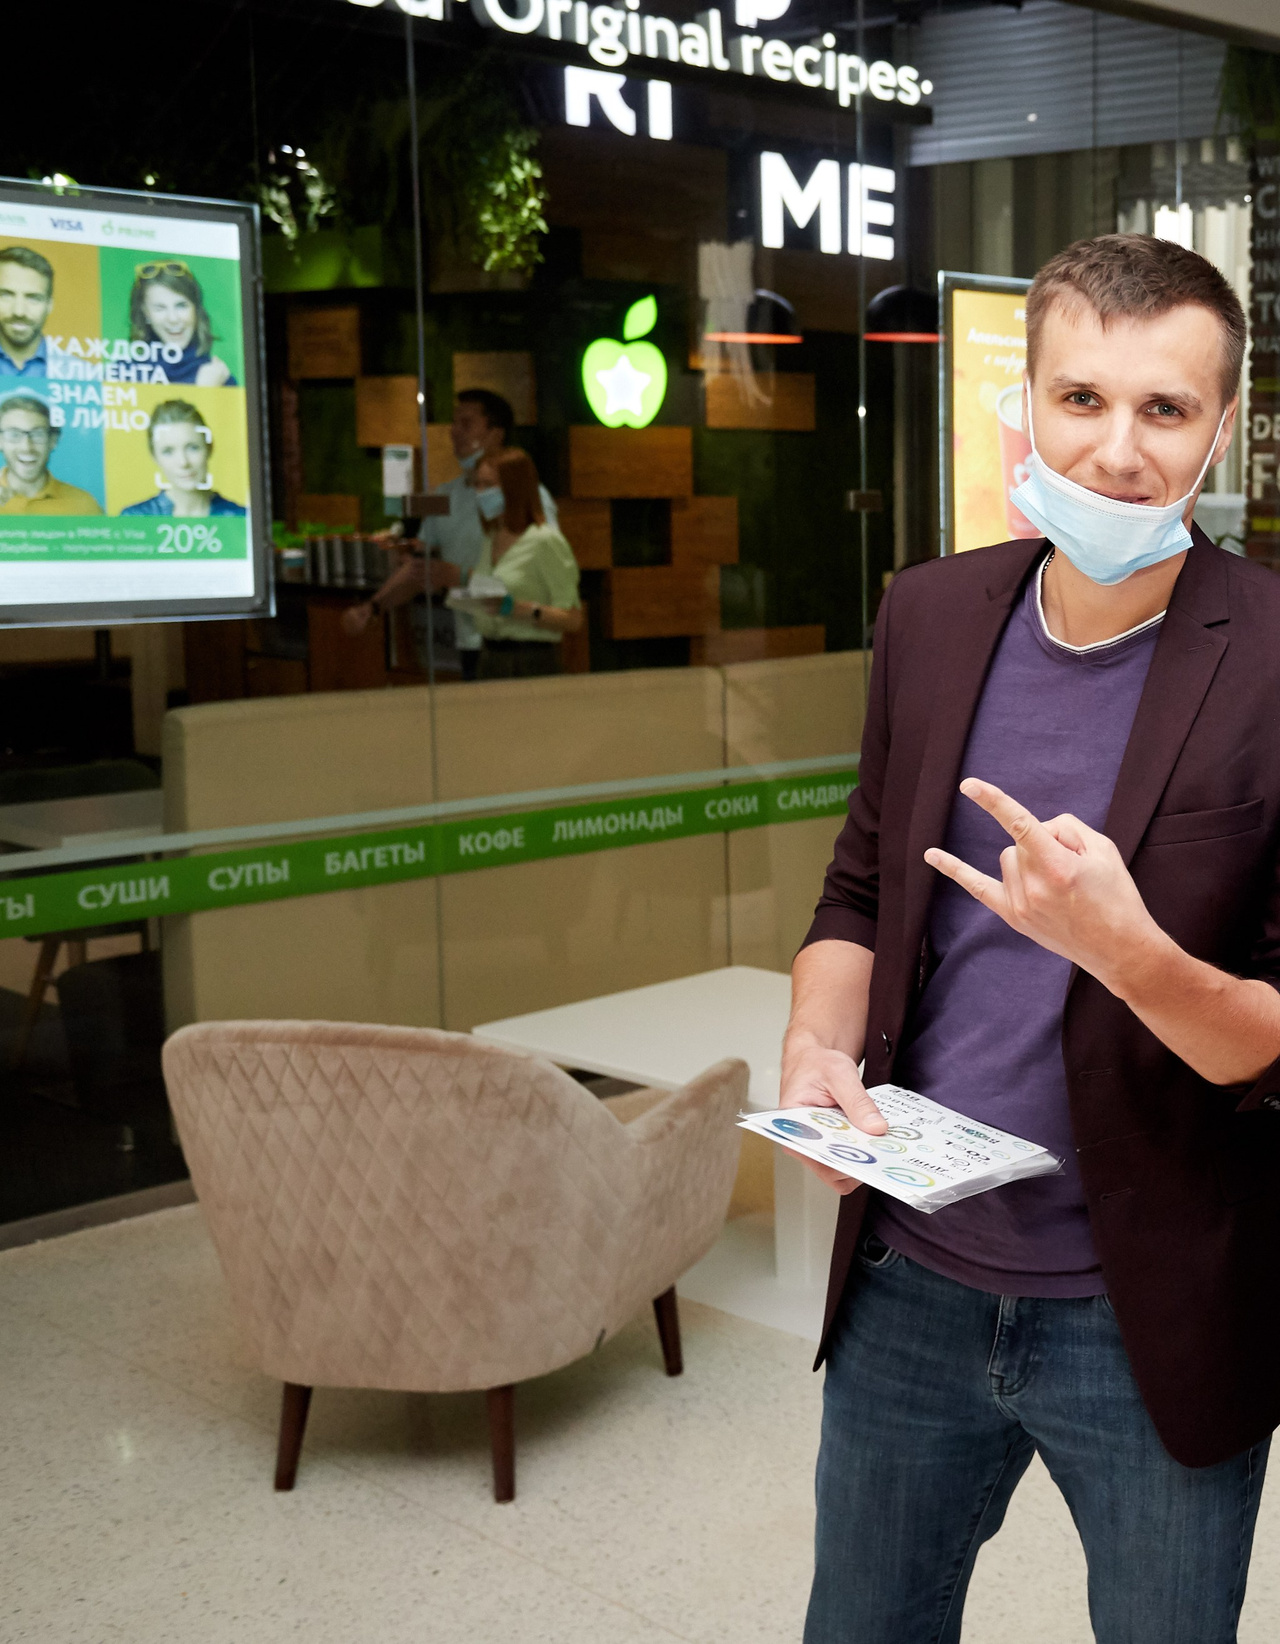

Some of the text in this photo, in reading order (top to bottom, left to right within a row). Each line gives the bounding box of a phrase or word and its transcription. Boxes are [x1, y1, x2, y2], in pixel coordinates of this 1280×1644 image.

[484, 0, 730, 71] Original
[760, 151, 896, 261] ME
[50, 217, 84, 231] VISA
[46, 335, 183, 364] КАЖДОГО
[47, 359, 170, 385] КЛИЕНТА
[48, 383, 138, 407] ЗНАЕМ
[50, 407, 150, 431] В ЛИЦО
[156, 523, 223, 554] 20%
[0, 783, 856, 921] Ы СУШИ СУПЫ БАГЕТЫ КОФЕ ЛИМОНАДЫ СОКИ САНДВИ
